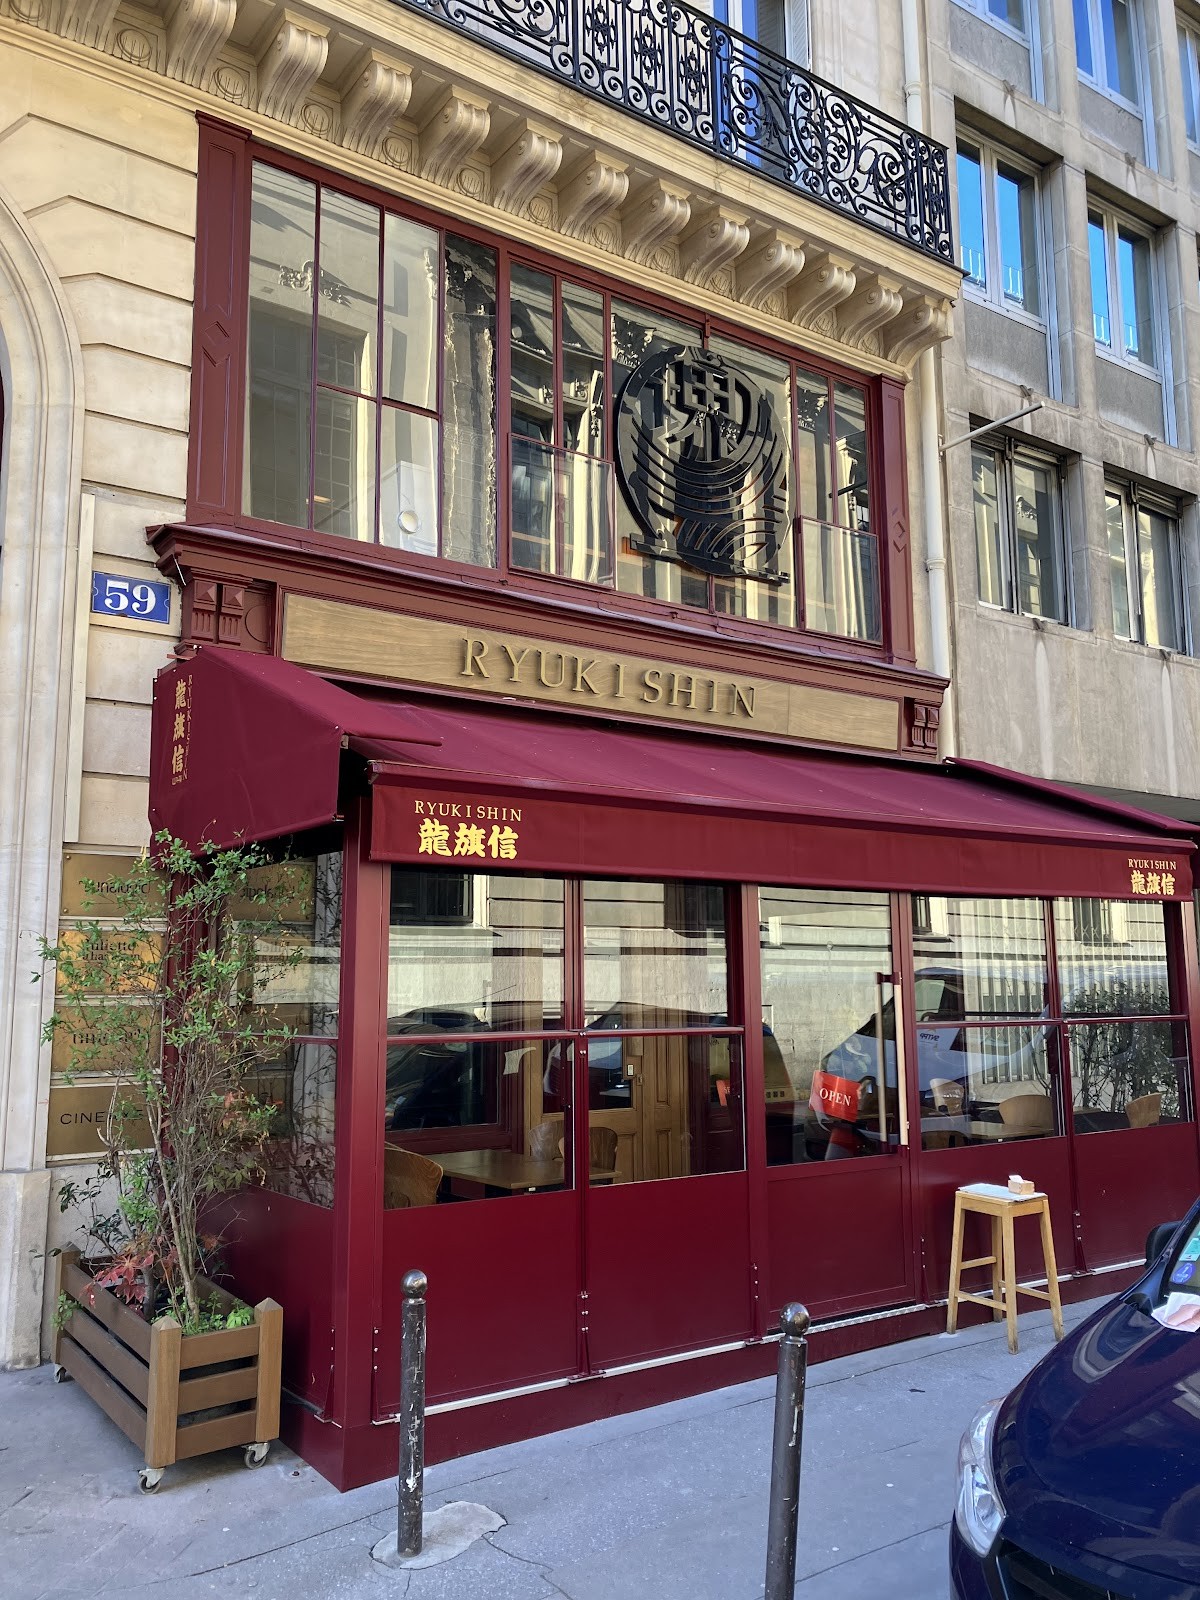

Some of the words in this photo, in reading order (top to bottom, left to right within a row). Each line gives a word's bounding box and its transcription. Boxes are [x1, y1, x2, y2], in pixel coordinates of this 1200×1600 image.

[104, 579, 156, 614] 59
[461, 637, 756, 718] RYUKISHIN
[172, 679, 186, 774] 龍旗信
[414, 799, 523, 822] RYUKISHIN
[417, 817, 520, 860] 龍旗信
[1127, 858, 1177, 870] RYUKISHIN
[1130, 869, 1176, 896] 龍旗信
[819, 1087, 852, 1107] OPEN
